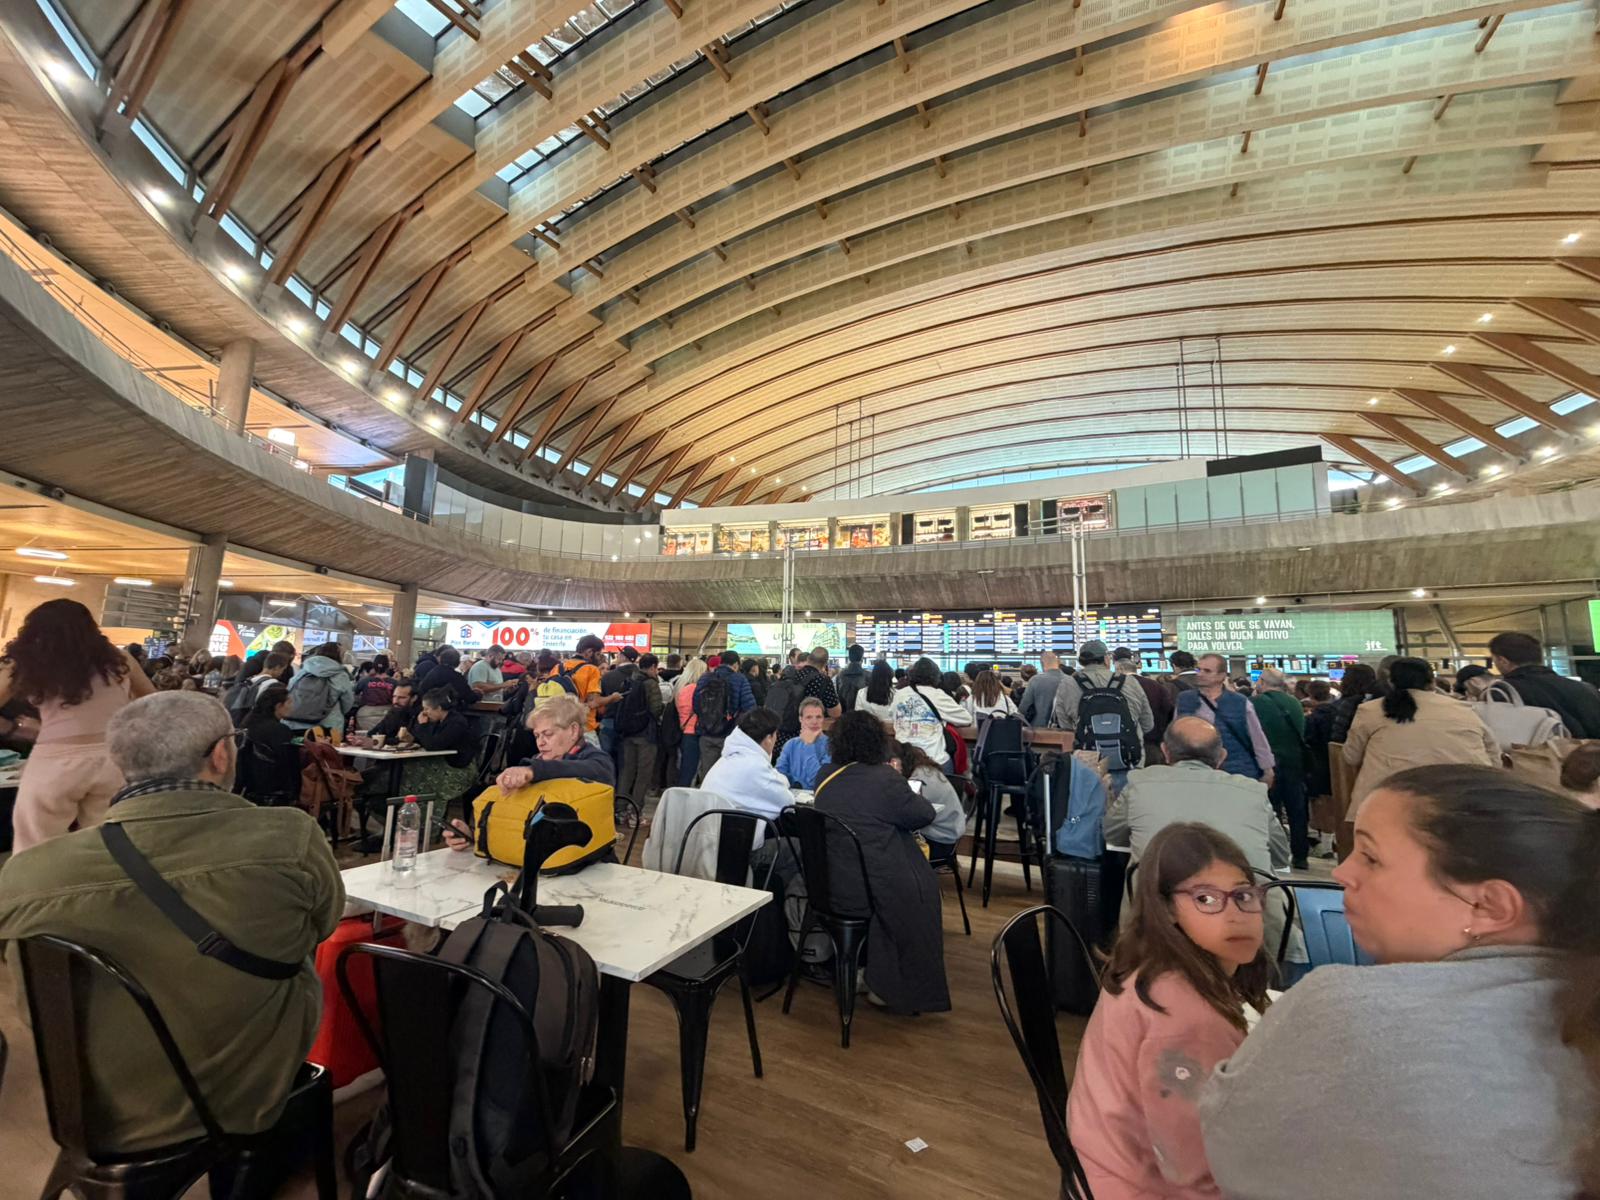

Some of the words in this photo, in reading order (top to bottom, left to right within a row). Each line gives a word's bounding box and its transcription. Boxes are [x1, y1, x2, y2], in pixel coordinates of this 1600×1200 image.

[1186, 621, 1212, 630] ANTES
[1214, 621, 1226, 630] DE
[1228, 620, 1246, 630] QUE
[1248, 620, 1261, 629] SE
[1263, 619, 1295, 630] VAYAN,
[492, 626, 539, 646] 100%
[1187, 631, 1212, 641] DALES
[1215, 631, 1228, 640] UN
[1230, 630, 1253, 640] BUEN
[1256, 630, 1289, 640] MOTIVO
[1187, 641, 1209, 651] PARA
[1211, 641, 1244, 650] VOLVER.
